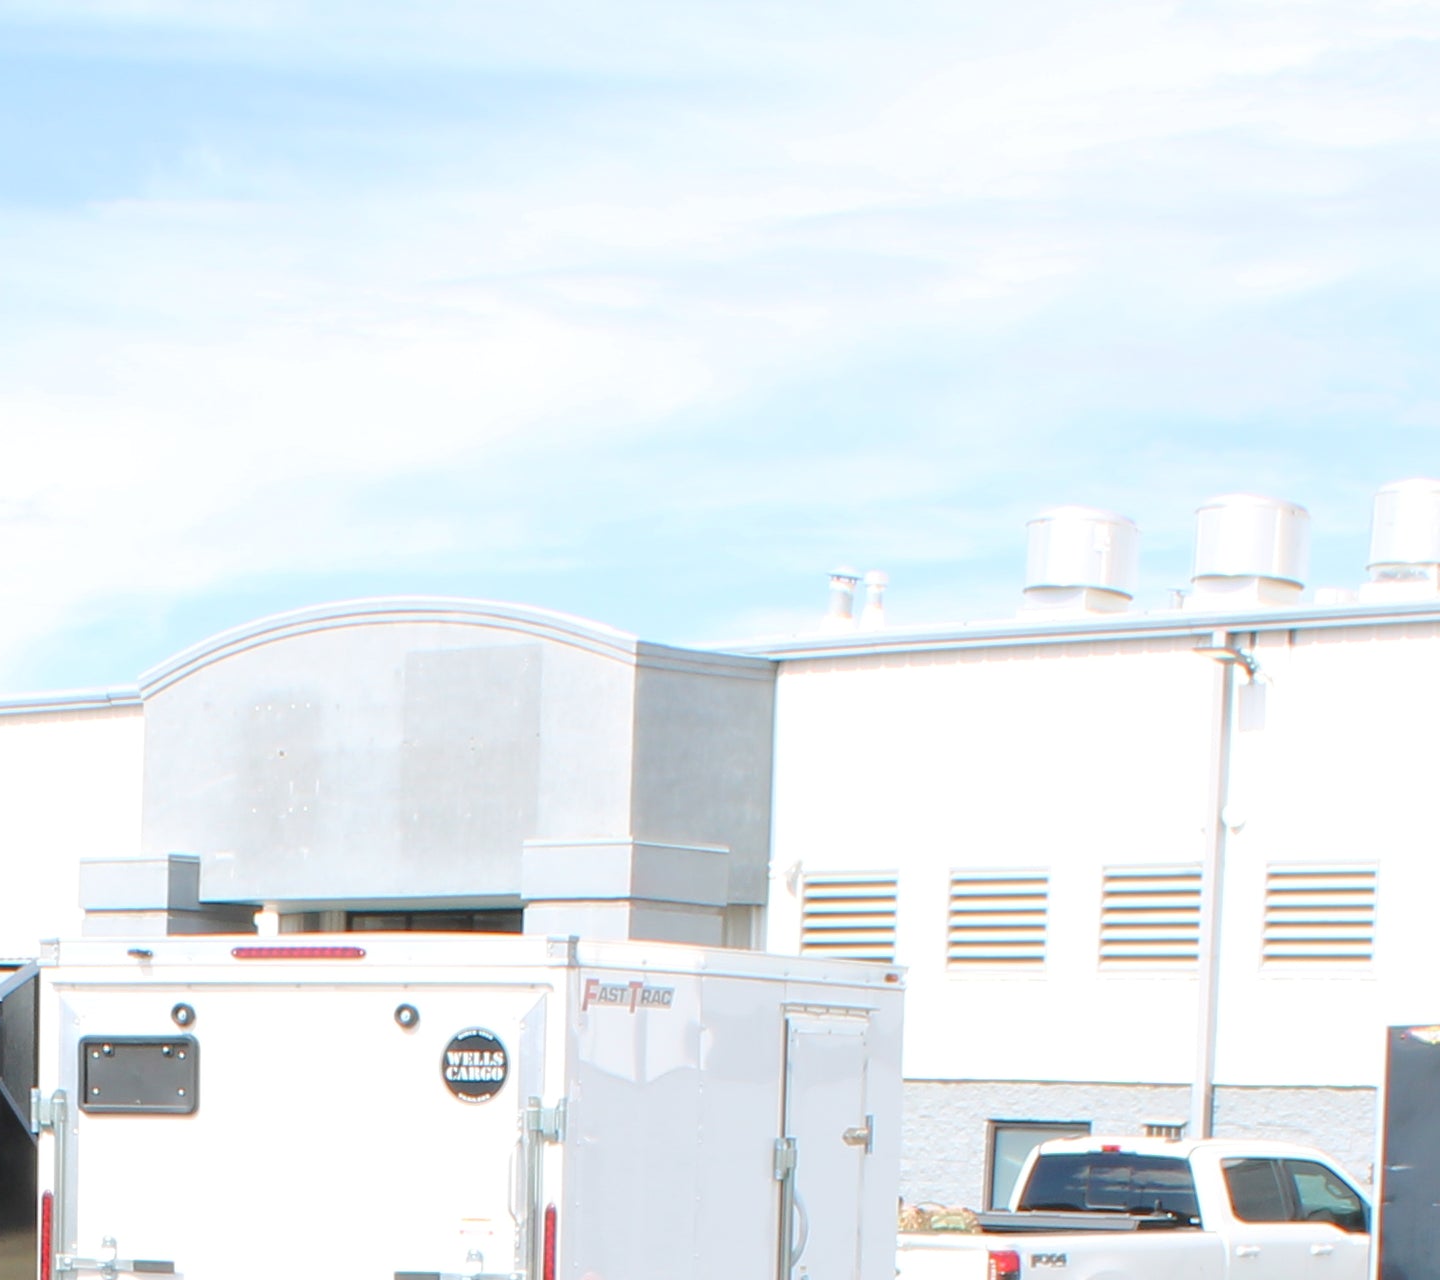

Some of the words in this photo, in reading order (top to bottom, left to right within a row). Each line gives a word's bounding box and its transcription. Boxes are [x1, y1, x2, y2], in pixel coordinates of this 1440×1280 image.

[582, 979, 627, 1012] FAST
[629, 981, 673, 1014] TRAC
[446, 1051, 505, 1067] WELLS
[445, 1066, 505, 1081] CARGO
[1031, 1253, 1067, 1268] FX4
